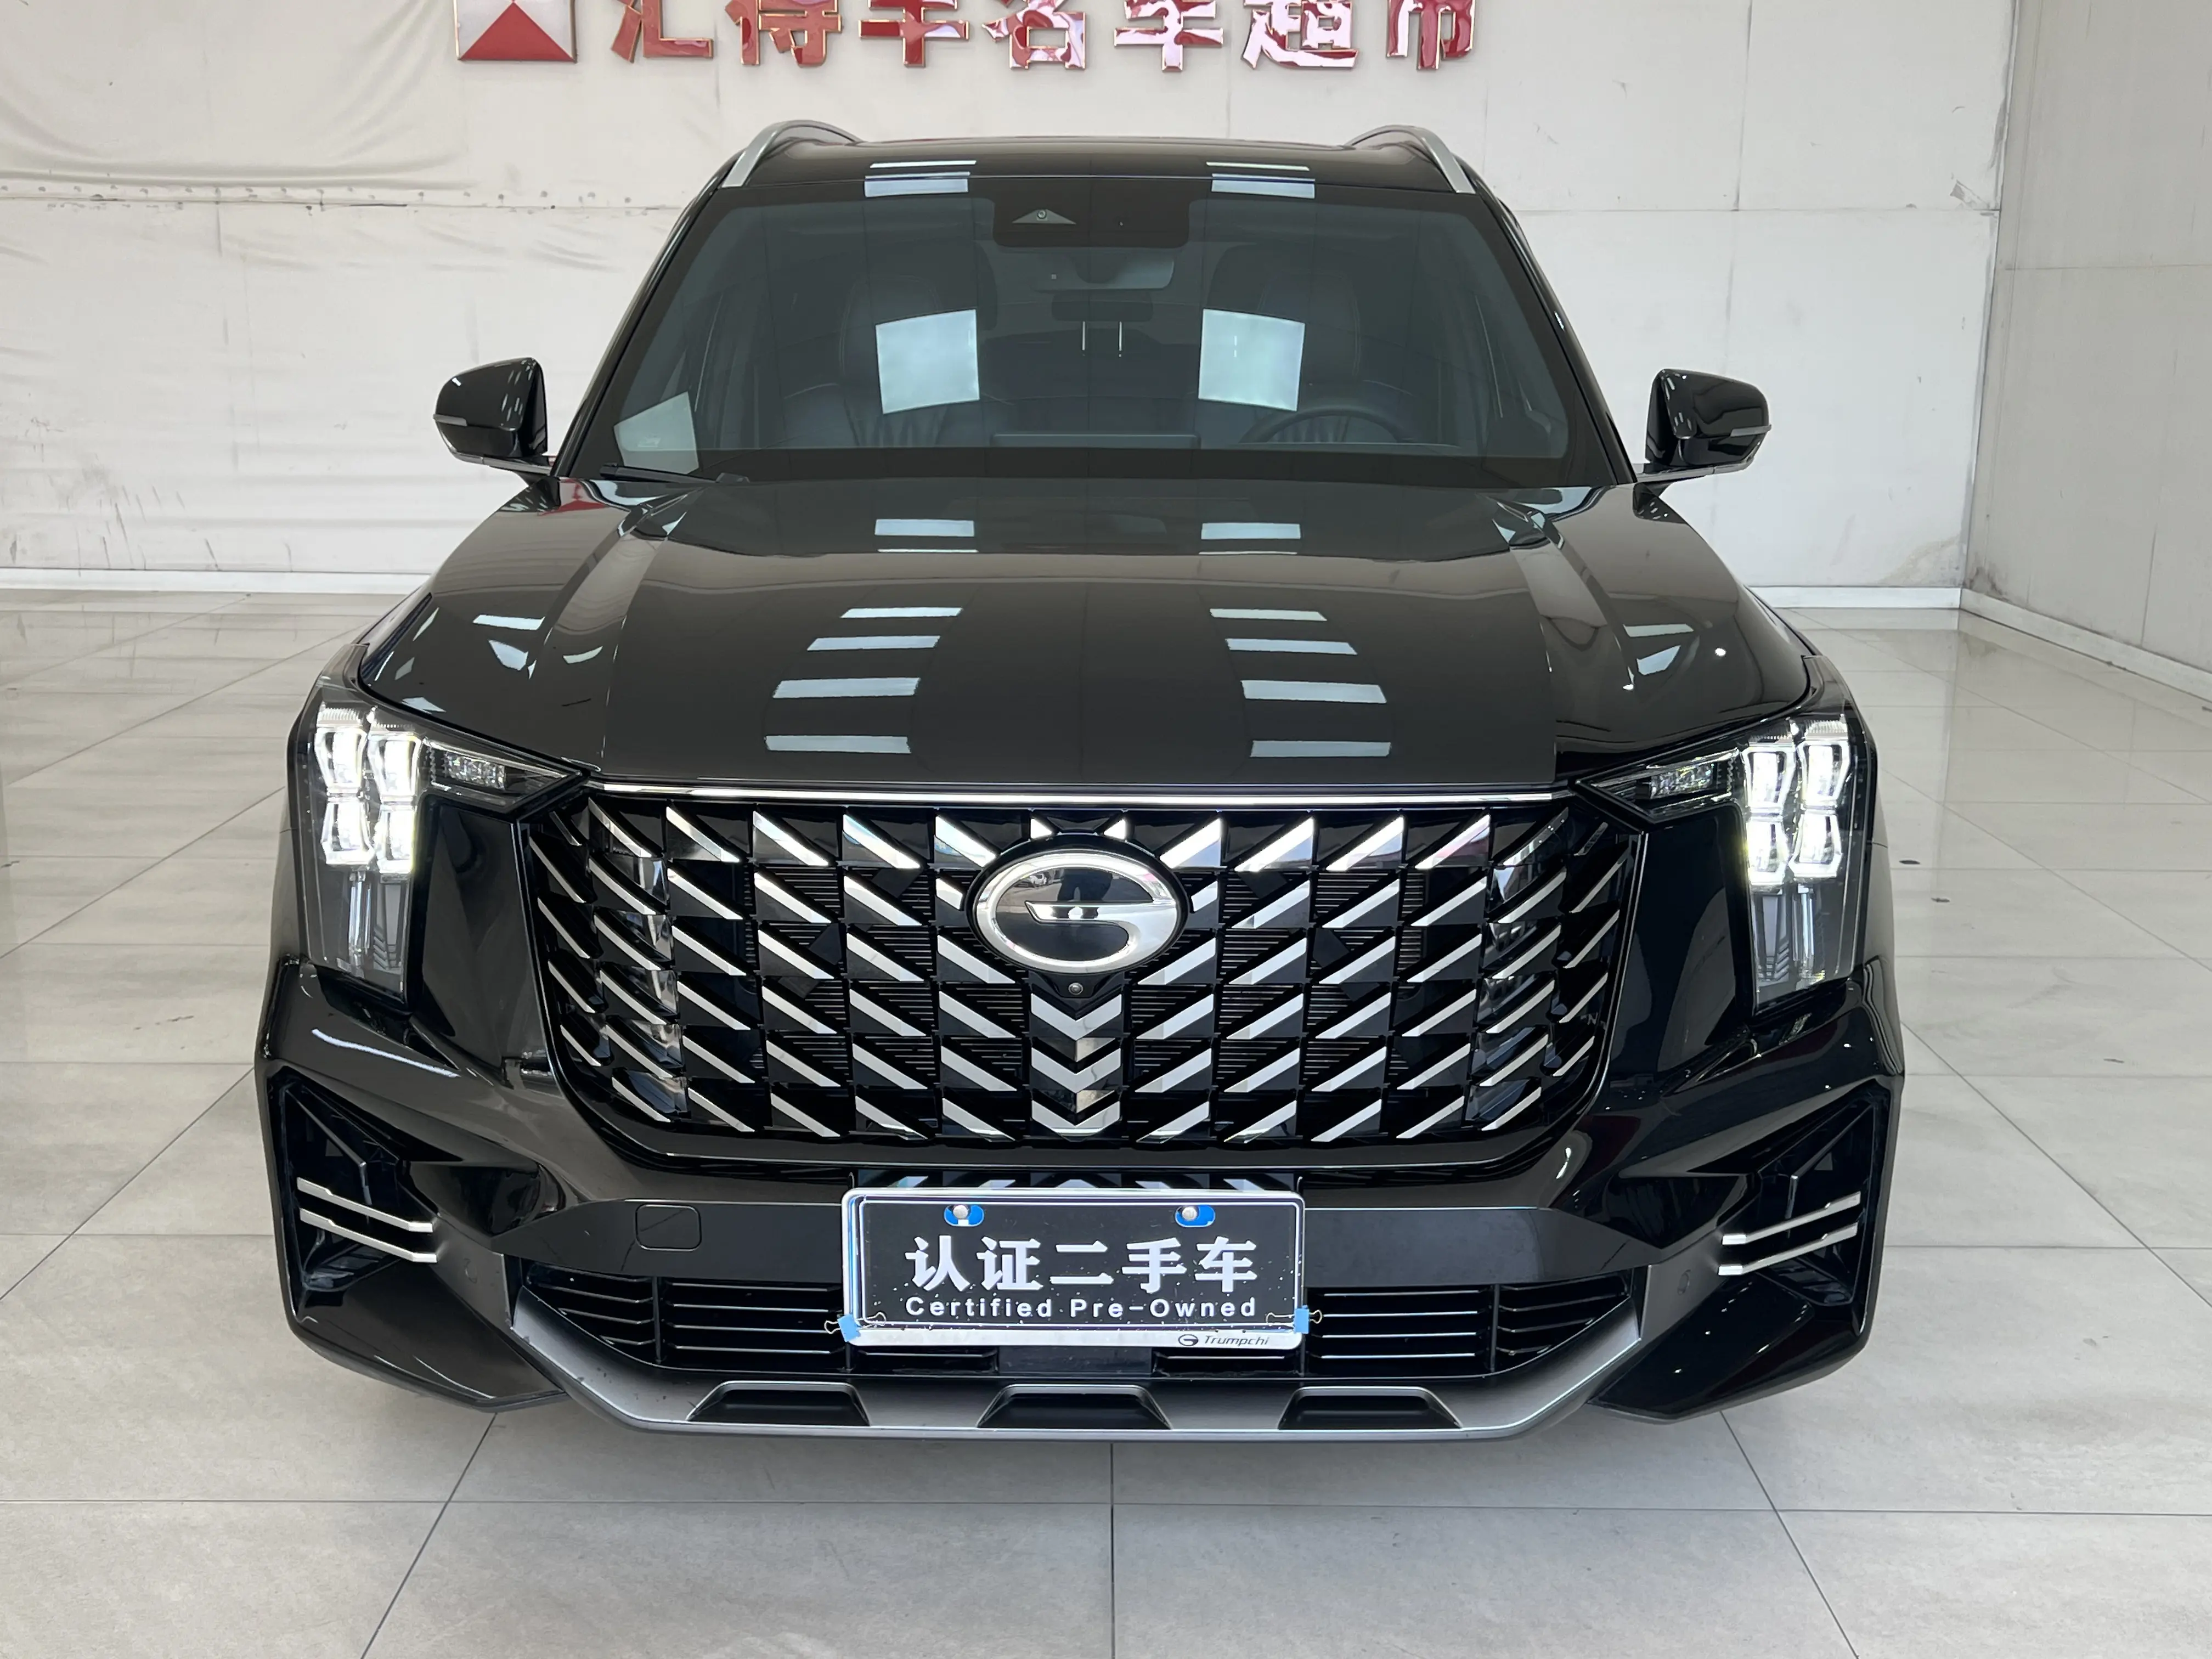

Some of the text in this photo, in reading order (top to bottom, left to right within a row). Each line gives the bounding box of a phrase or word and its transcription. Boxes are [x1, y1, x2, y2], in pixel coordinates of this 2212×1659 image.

[905, 1235, 1257, 1293] 认证二手车
[905, 1297, 1255, 1317] Certified Pre-Owned
[1204, 1335, 1269, 1346] Trumpchi
